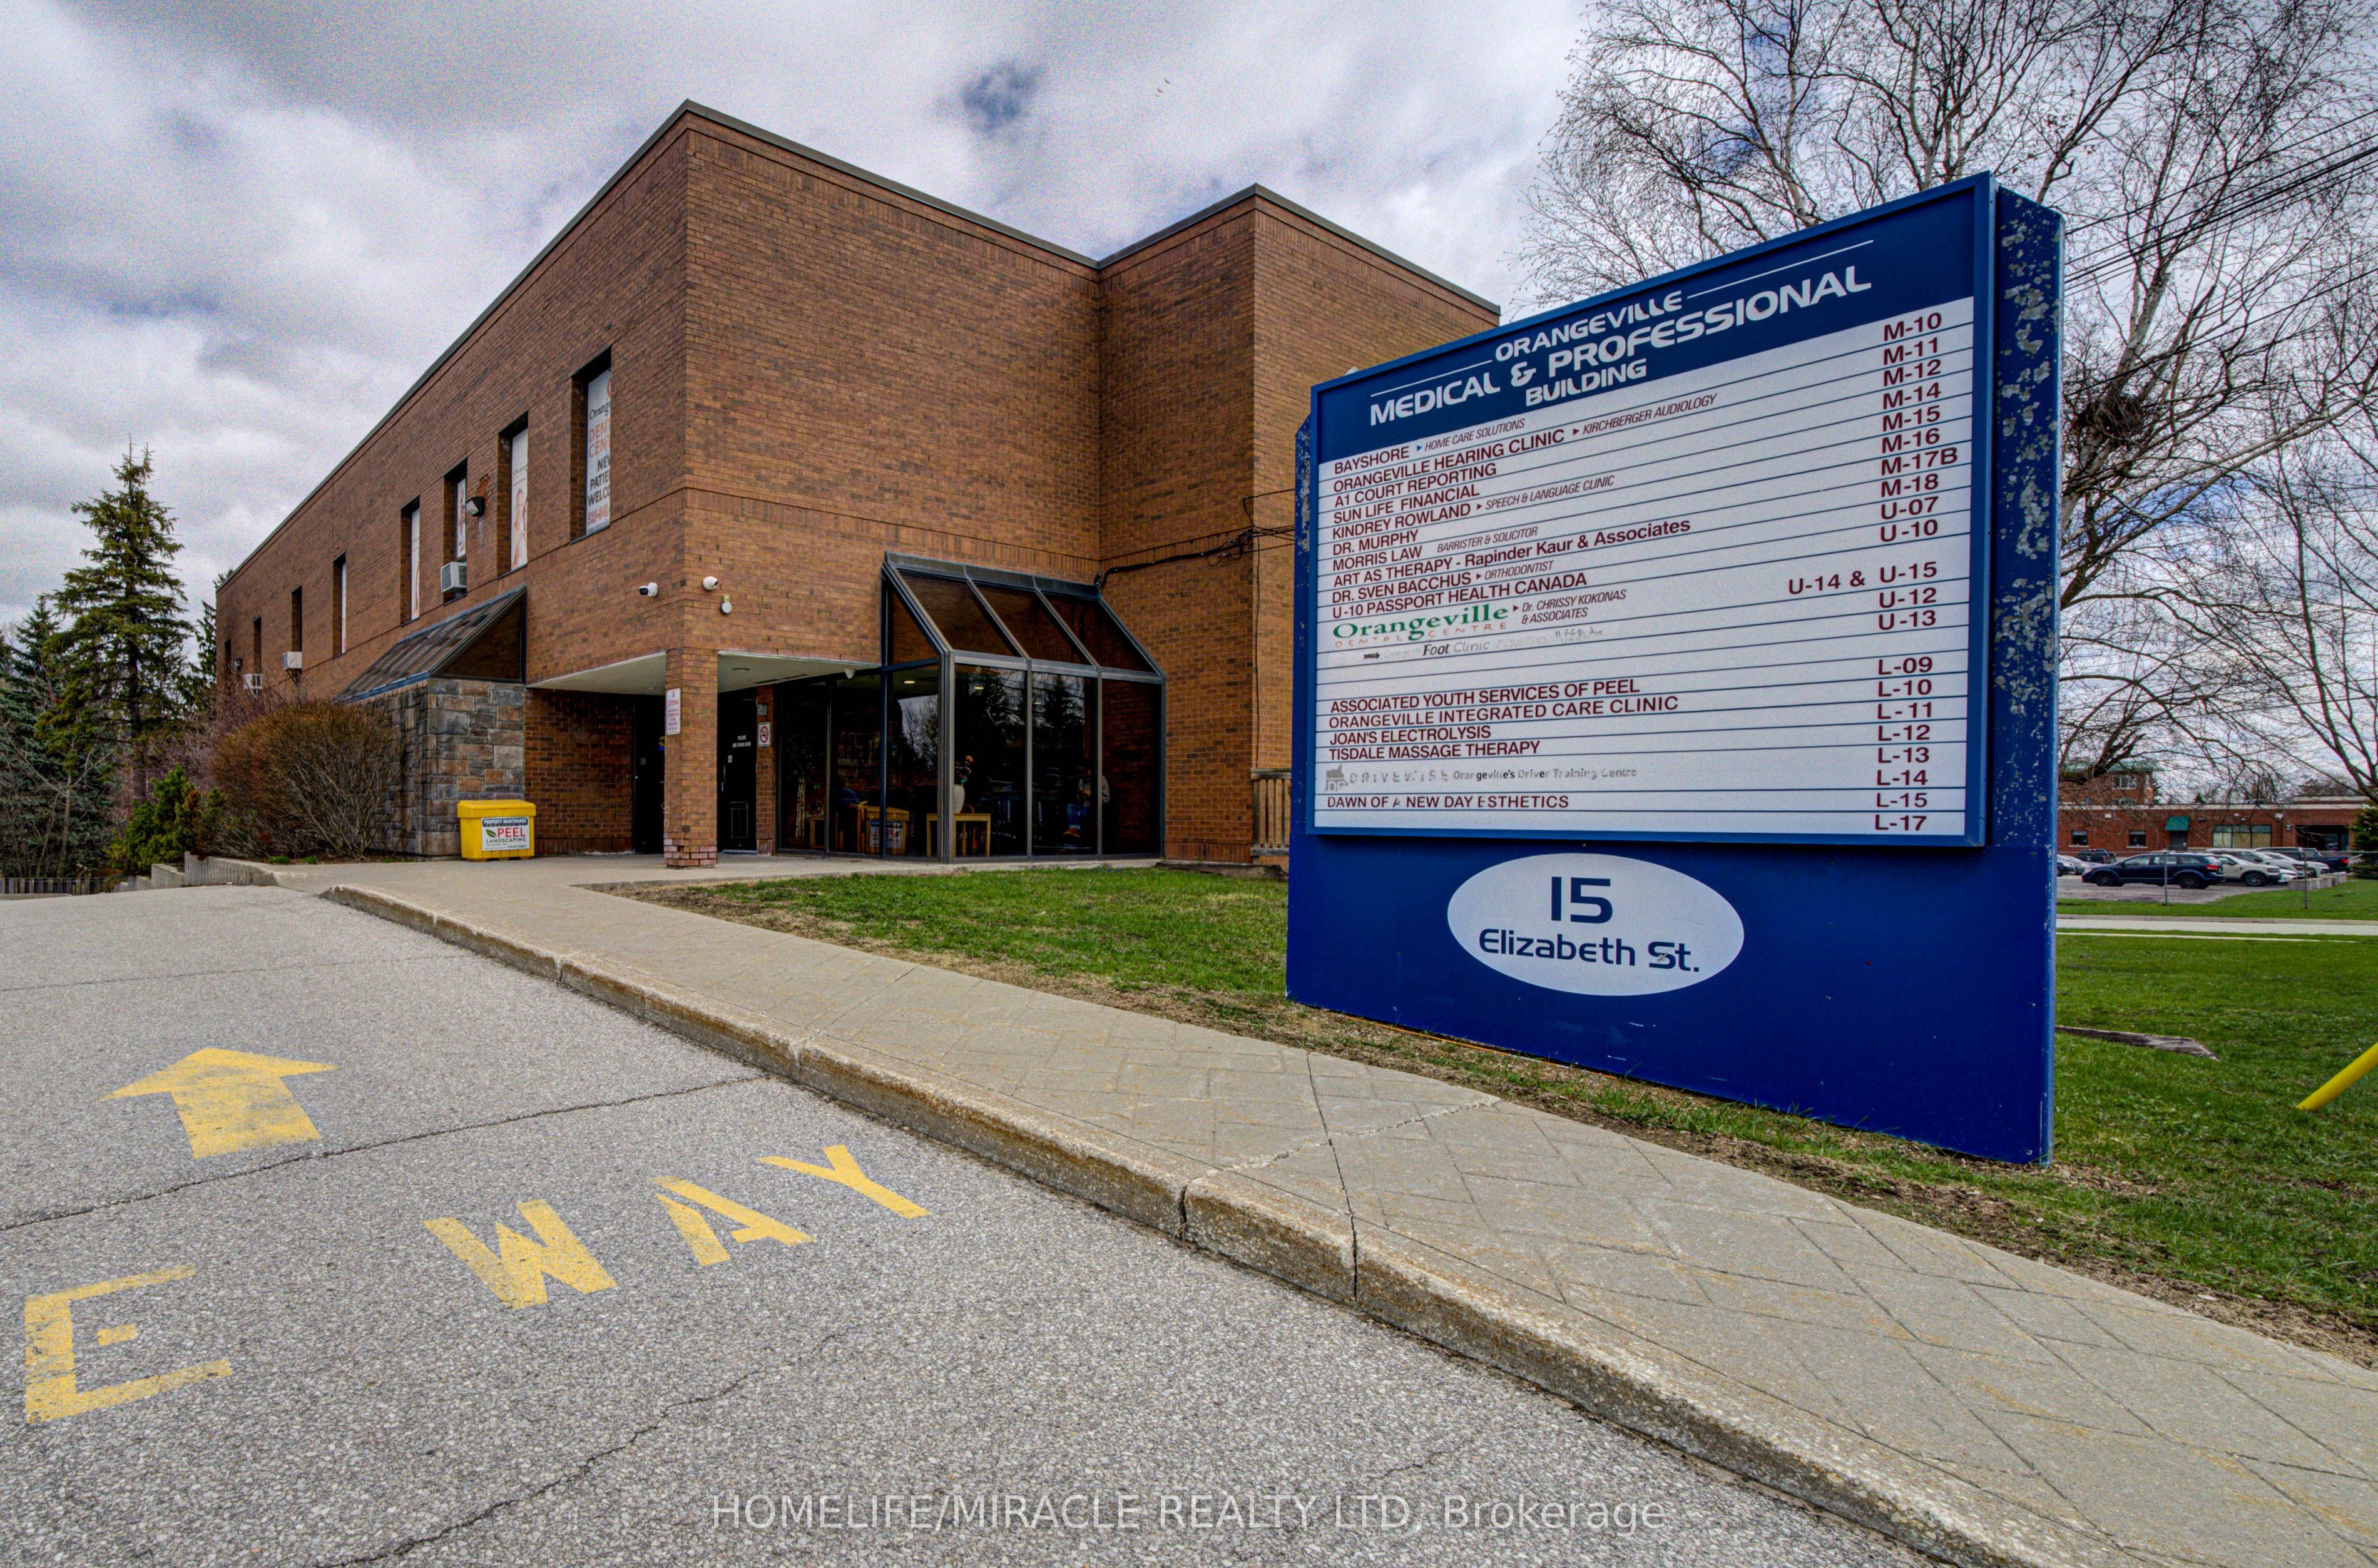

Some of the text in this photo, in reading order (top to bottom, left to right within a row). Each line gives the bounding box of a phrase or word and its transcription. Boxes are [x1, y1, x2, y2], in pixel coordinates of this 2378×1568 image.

[1495, 290, 1683, 362] ORANGEVILLE
[1884, 312, 1942, 341] M-10
[1370, 265, 1872, 426] MEDICAL & PROFESSIONAL
[1884, 337, 1937, 365] M-11
[1526, 358, 1647, 407] BUILDING
[1884, 359, 1941, 387] M-12
[1882, 382, 1941, 410] M-14
[1882, 405, 1941, 432] M-15
[1333, 394, 1718, 492] ORANGEVILLE HEARING CLINIC KIRCHBERGER AUDIOLOGY
[1334, 419, 1526, 474] BAYSHORE HOME CARE SOLUTIONS
[1882, 427, 1939, 454] M-16
[1880, 447, 1957, 476] M-17B
[1335, 462, 1496, 507] A1 COURT REPORTING
[1880, 474, 1939, 497] M-18
[1332, 476, 1615, 540] KINDREY ROWLAND SPEECH & LANGUAGE CLINIC
[1334, 484, 1480, 524] SUN LIFE FINANCIAL
[1880, 496, 1939, 519] U-07
[1332, 529, 1419, 556] DR. MURPHY
[1880, 519, 1938, 542] U-10
[1332, 526, 1538, 571] MORRIS LAW BARRISTER & SOLICITOR
[1334, 572, 1360, 588] ART
[1364, 569, 1382, 583] AS
[1385, 557, 1452, 579] THERAPY
[1465, 545, 1532, 567] Rapinder
[1536, 538, 1573, 556] Kaur
[1578, 535, 1588, 548] &
[1594, 520, 1690, 546] Associates
[1332, 560, 1554, 604] DR. SVEN BACCHUS ORTHODONTIST
[1789, 561, 1937, 594] U-14 & U-15
[1333, 573, 1587, 619] U-10 PASSPORT HEALTH CANADA
[1522, 589, 1626, 613] Dr. CHRISSY KOKONAS
[1879, 587, 1937, 608] U-12
[1333, 604, 1509, 641] Orangeville
[1522, 607, 1588, 624] & ASSOCIATES
[1879, 610, 1936, 631] U-13
[1428, 622, 1507, 637] CENTRE
[1422, 644, 1449, 656] Foot
[1453, 640, 1490, 653] Clinic
[1879, 656, 1933, 675] L-09
[1331, 679, 1640, 713] ASSOCIATED YOUTH SERVICES OF PEEL
[1879, 679, 1932, 697] L-10
[1329, 696, 1678, 728] ORANGEVILLE INTEGRATED CARE CLINIC
[1877, 701, 1931, 720] L-11
[1330, 725, 1491, 745] JOAN'S ELECTROLYSIS
[1878, 725, 1931, 741] L-12
[1329, 741, 1540, 760] TISDALE MASSAGE THERAPY
[1878, 747, 1929, 763] L-13
[1453, 769, 1515, 781] Orangeville's
[1518, 768, 1549, 779] Driver
[1553, 768, 1597, 780] Training
[1877, 770, 1928, 786] L-14
[1328, 797, 1366, 808] DAWN
[1370, 797, 1389, 808] OF
[1407, 797, 1439, 808] NEW
[1444, 796, 1473, 808] DAY
[1478, 796, 1569, 808] ESTHETICS
[1877, 793, 1927, 808] L-15
[498, 827, 526, 838] PEEL
[1875, 814, 1927, 831] L-17
[1551, 876, 1613, 924] 15
[1479, 929, 1700, 972] Elizabeth St.
[424, 1144, 931, 1311] WAY
